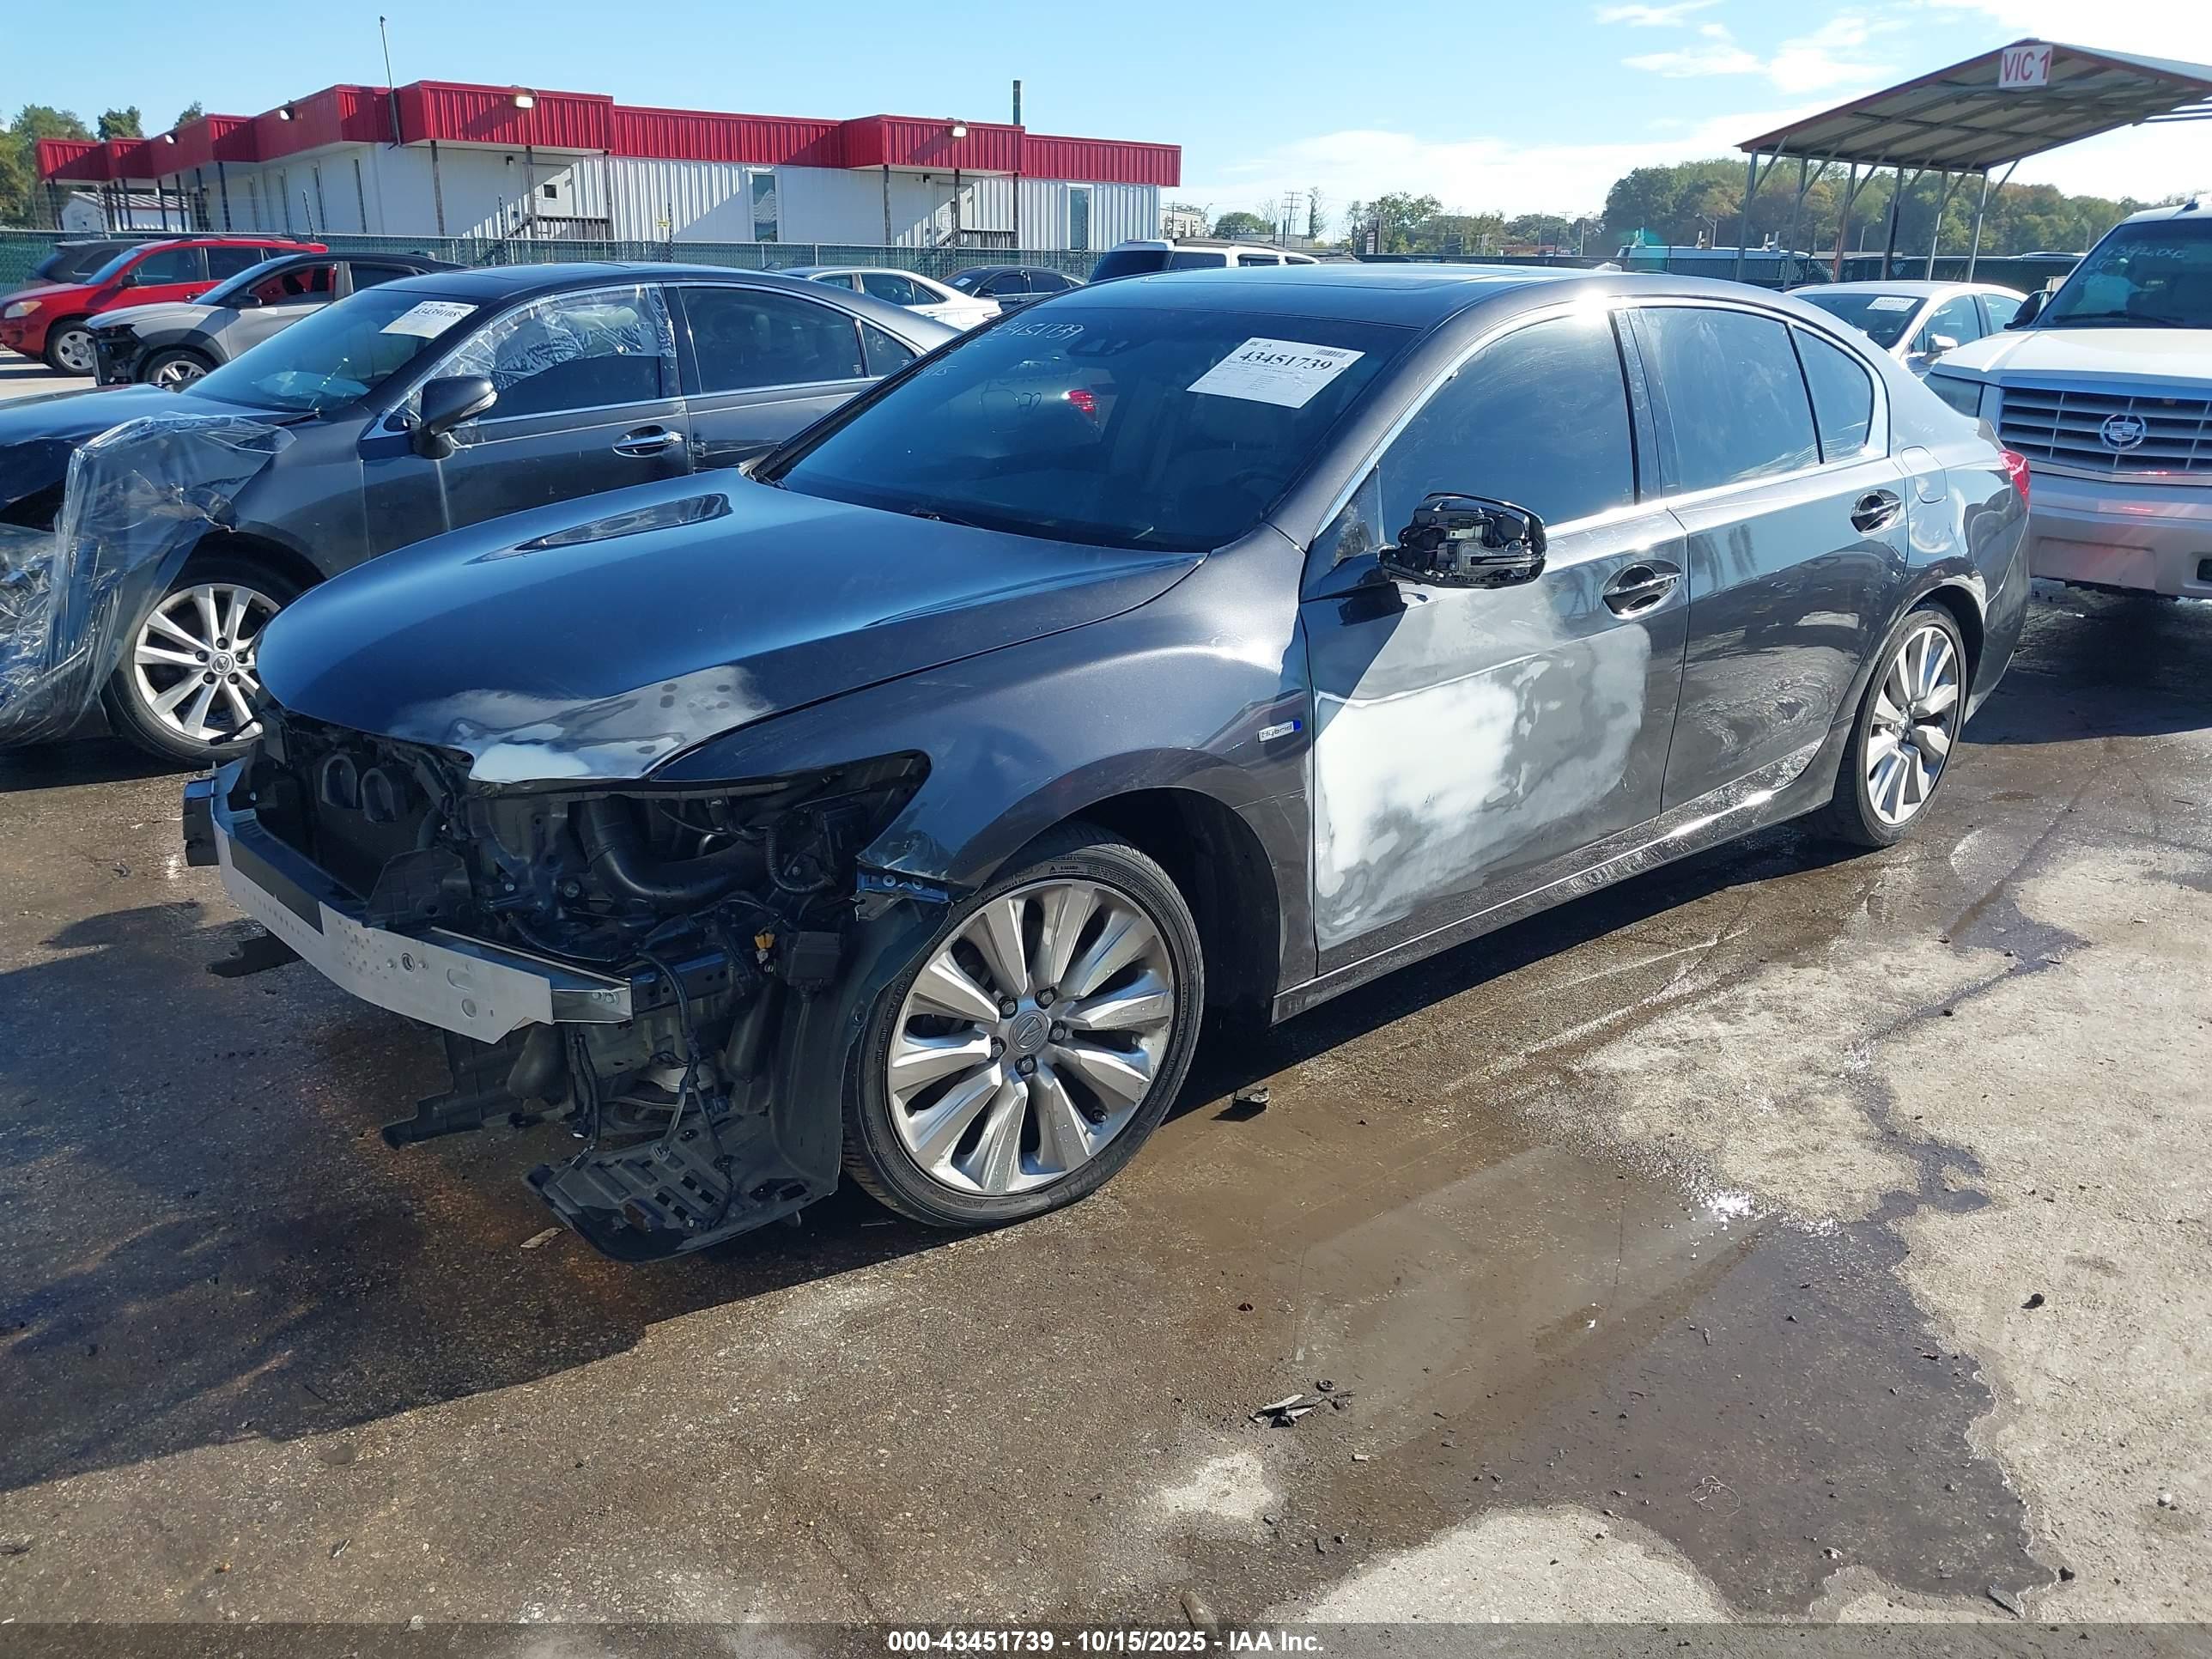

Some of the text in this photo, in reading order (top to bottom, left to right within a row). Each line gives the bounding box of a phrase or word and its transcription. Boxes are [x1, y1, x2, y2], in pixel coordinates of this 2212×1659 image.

[2003, 50, 2051, 82] VIC 1
[1239, 350, 1334, 371] 43451739
[1261, 723, 1292, 738] Hybrid
